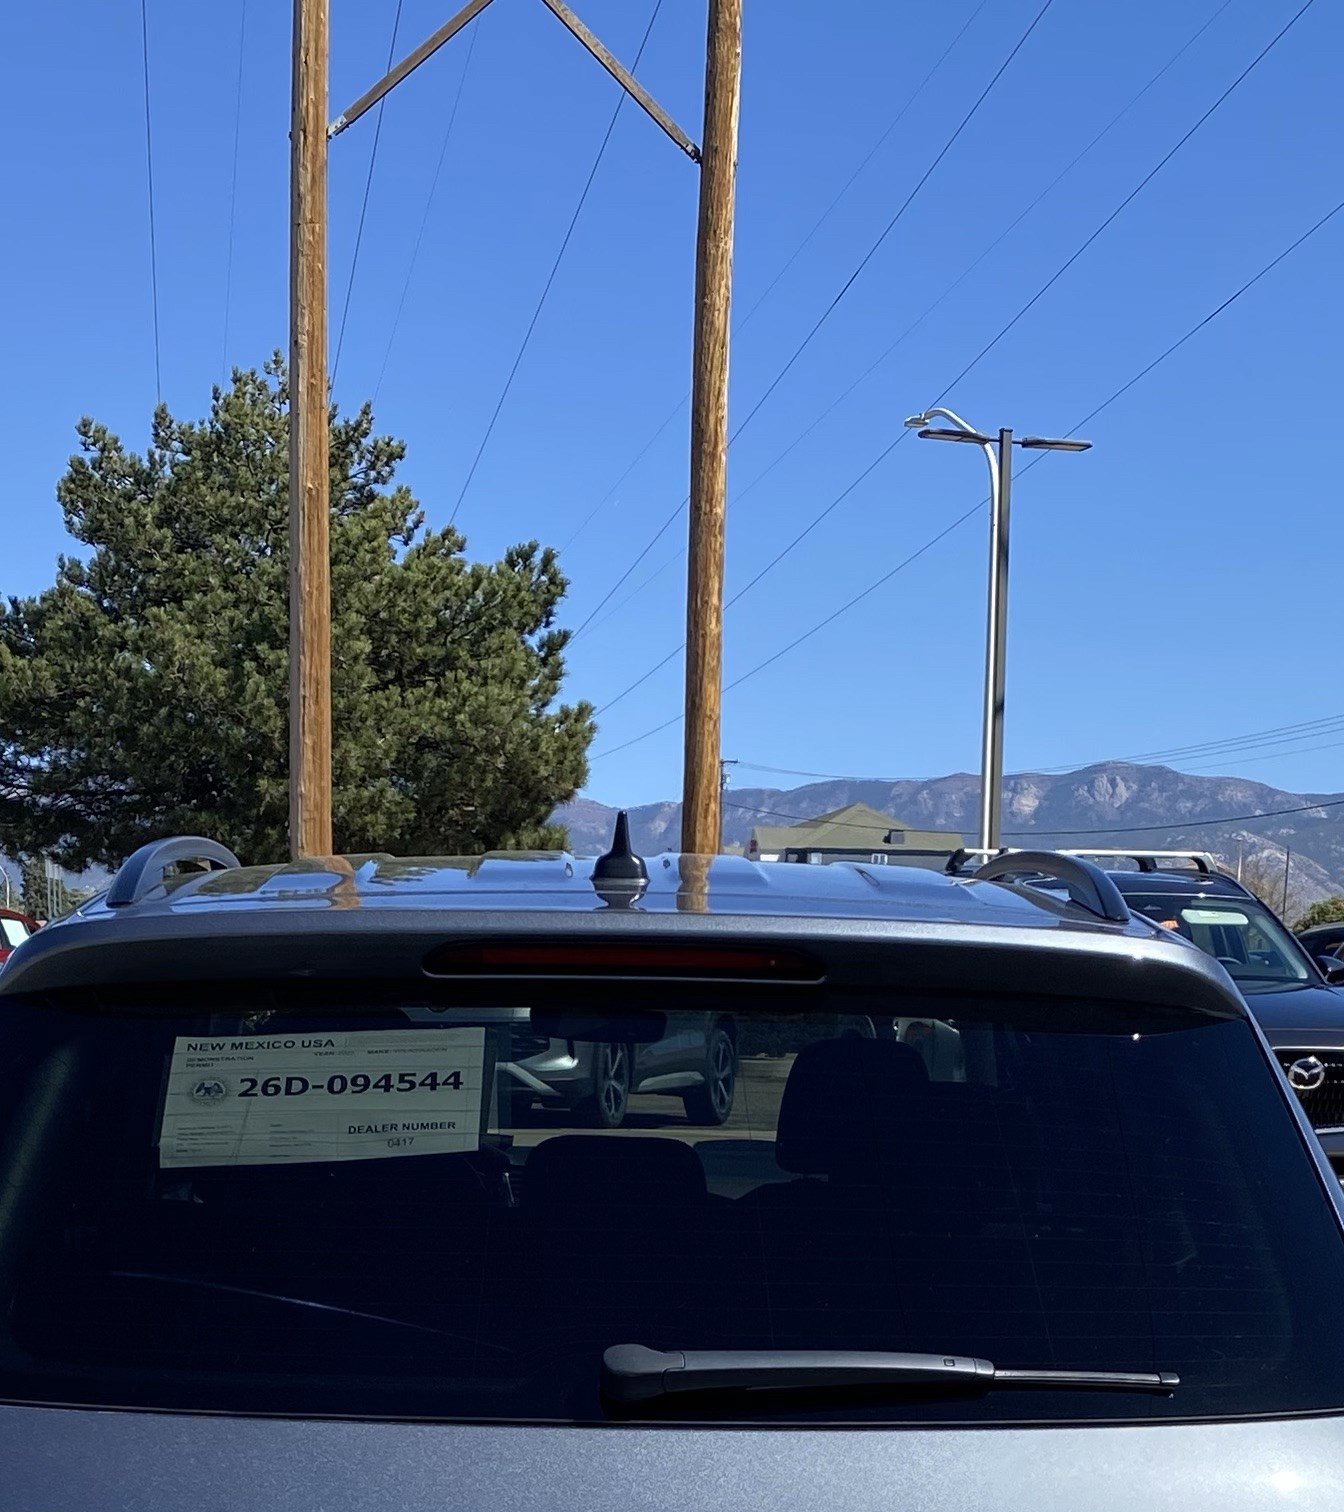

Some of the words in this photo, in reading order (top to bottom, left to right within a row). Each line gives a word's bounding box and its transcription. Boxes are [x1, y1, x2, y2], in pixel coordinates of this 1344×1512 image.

[187, 1042, 225, 1052] NEW
[230, 1040, 296, 1051] MEXICO
[301, 1039, 335, 1048] USA
[237, 1070, 464, 1098] 26D-094544
[348, 1123, 398, 1135] DEALER
[402, 1121, 456, 1131] NUMBER
